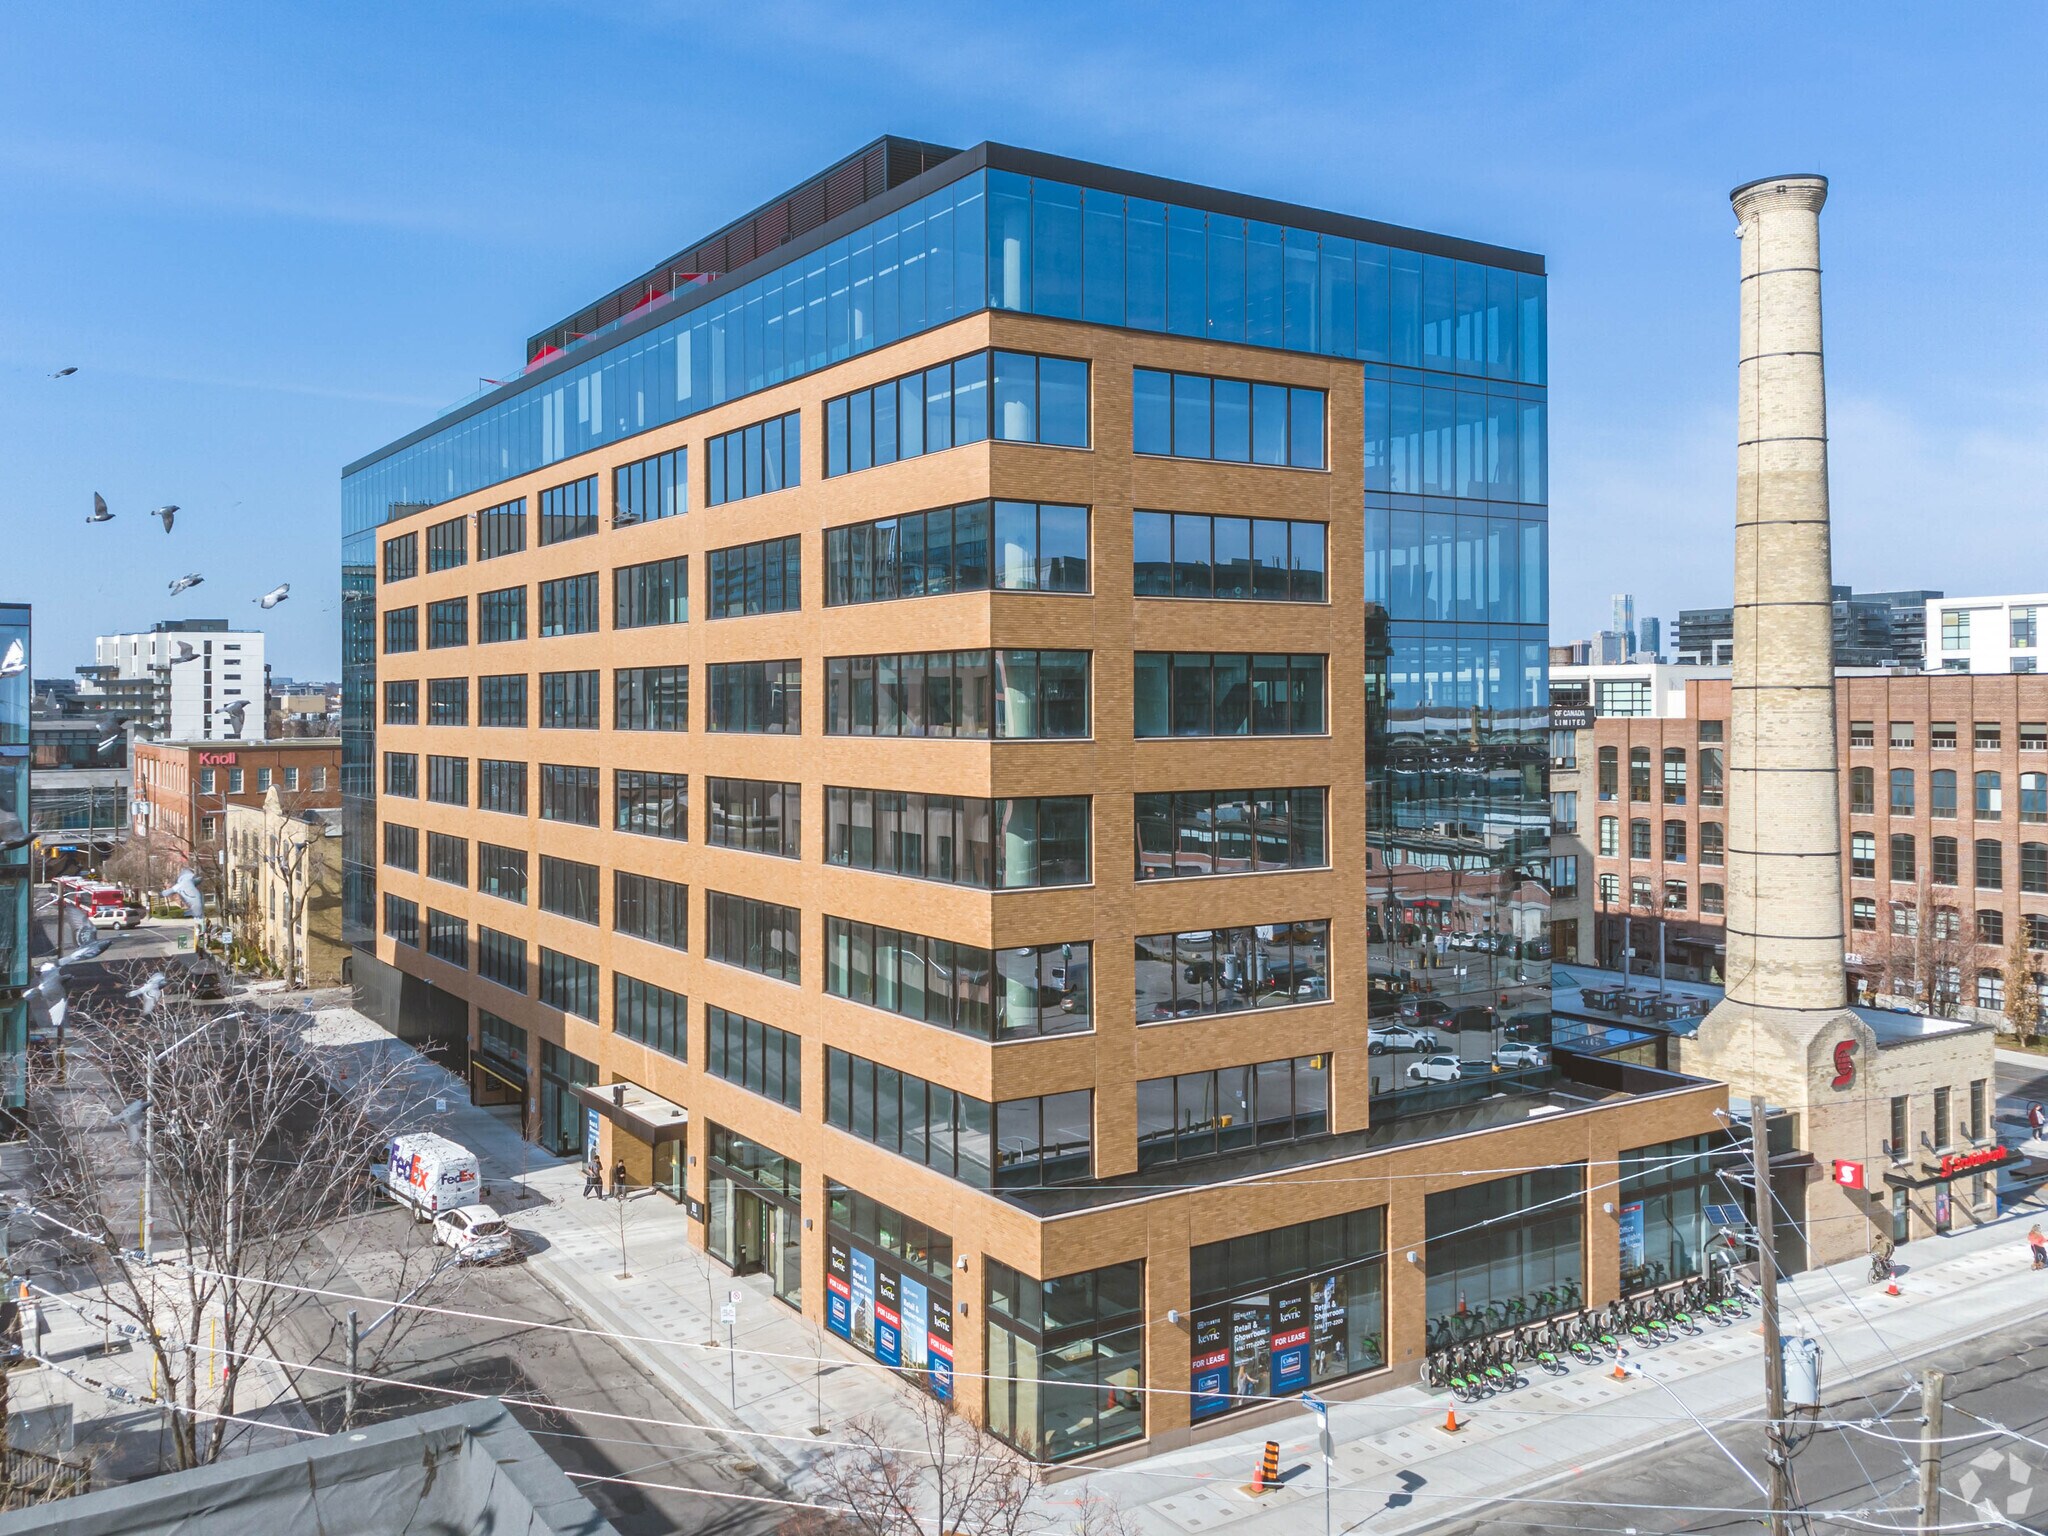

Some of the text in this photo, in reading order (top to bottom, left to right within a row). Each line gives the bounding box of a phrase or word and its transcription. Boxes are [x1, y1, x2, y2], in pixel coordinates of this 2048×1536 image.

[199, 752, 235, 765] Knoll
[390, 1143, 429, 1192] FedEx
[441, 1168, 475, 1185] FedEx
[829, 1278, 849, 1295] FOR LEASE
[877, 1306, 898, 1325] FOR LEASE
[1314, 1308, 1345, 1321] Showroom
[1234, 1320, 1258, 1334] Retail &
[1234, 1329, 1267, 1342] Showroom
[1275, 1337, 1287, 1347] FOR
[1287, 1332, 1306, 1343] LEASE
[930, 1338, 940, 1349] FOR
[1192, 1361, 1205, 1369] FOR
[1206, 1354, 1226, 1366] LEASE
